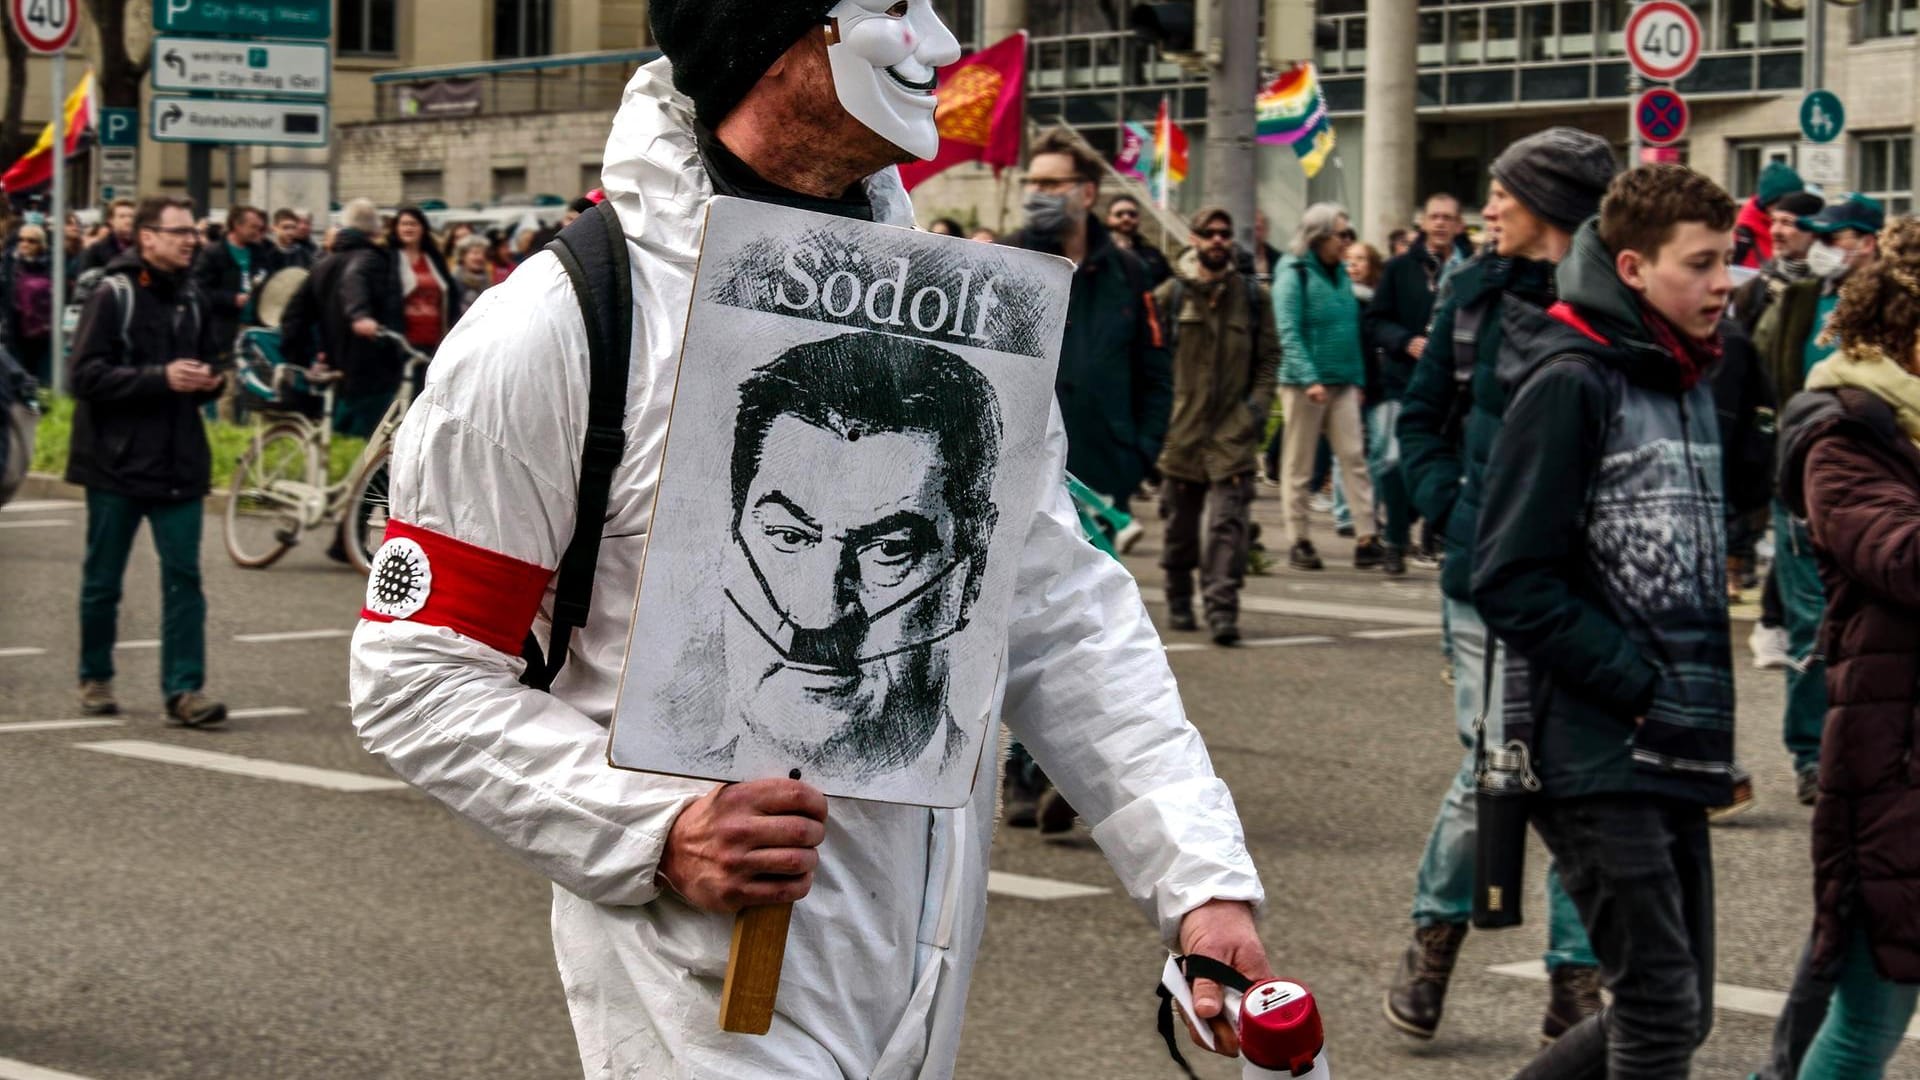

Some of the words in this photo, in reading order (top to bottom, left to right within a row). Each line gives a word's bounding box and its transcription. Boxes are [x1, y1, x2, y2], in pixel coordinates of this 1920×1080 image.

[28, 0, 65, 28] 40
[167, 0, 192, 25] P
[1642, 23, 1684, 57] 40
[109, 114, 128, 139] P
[775, 247, 1003, 342] Södolf
